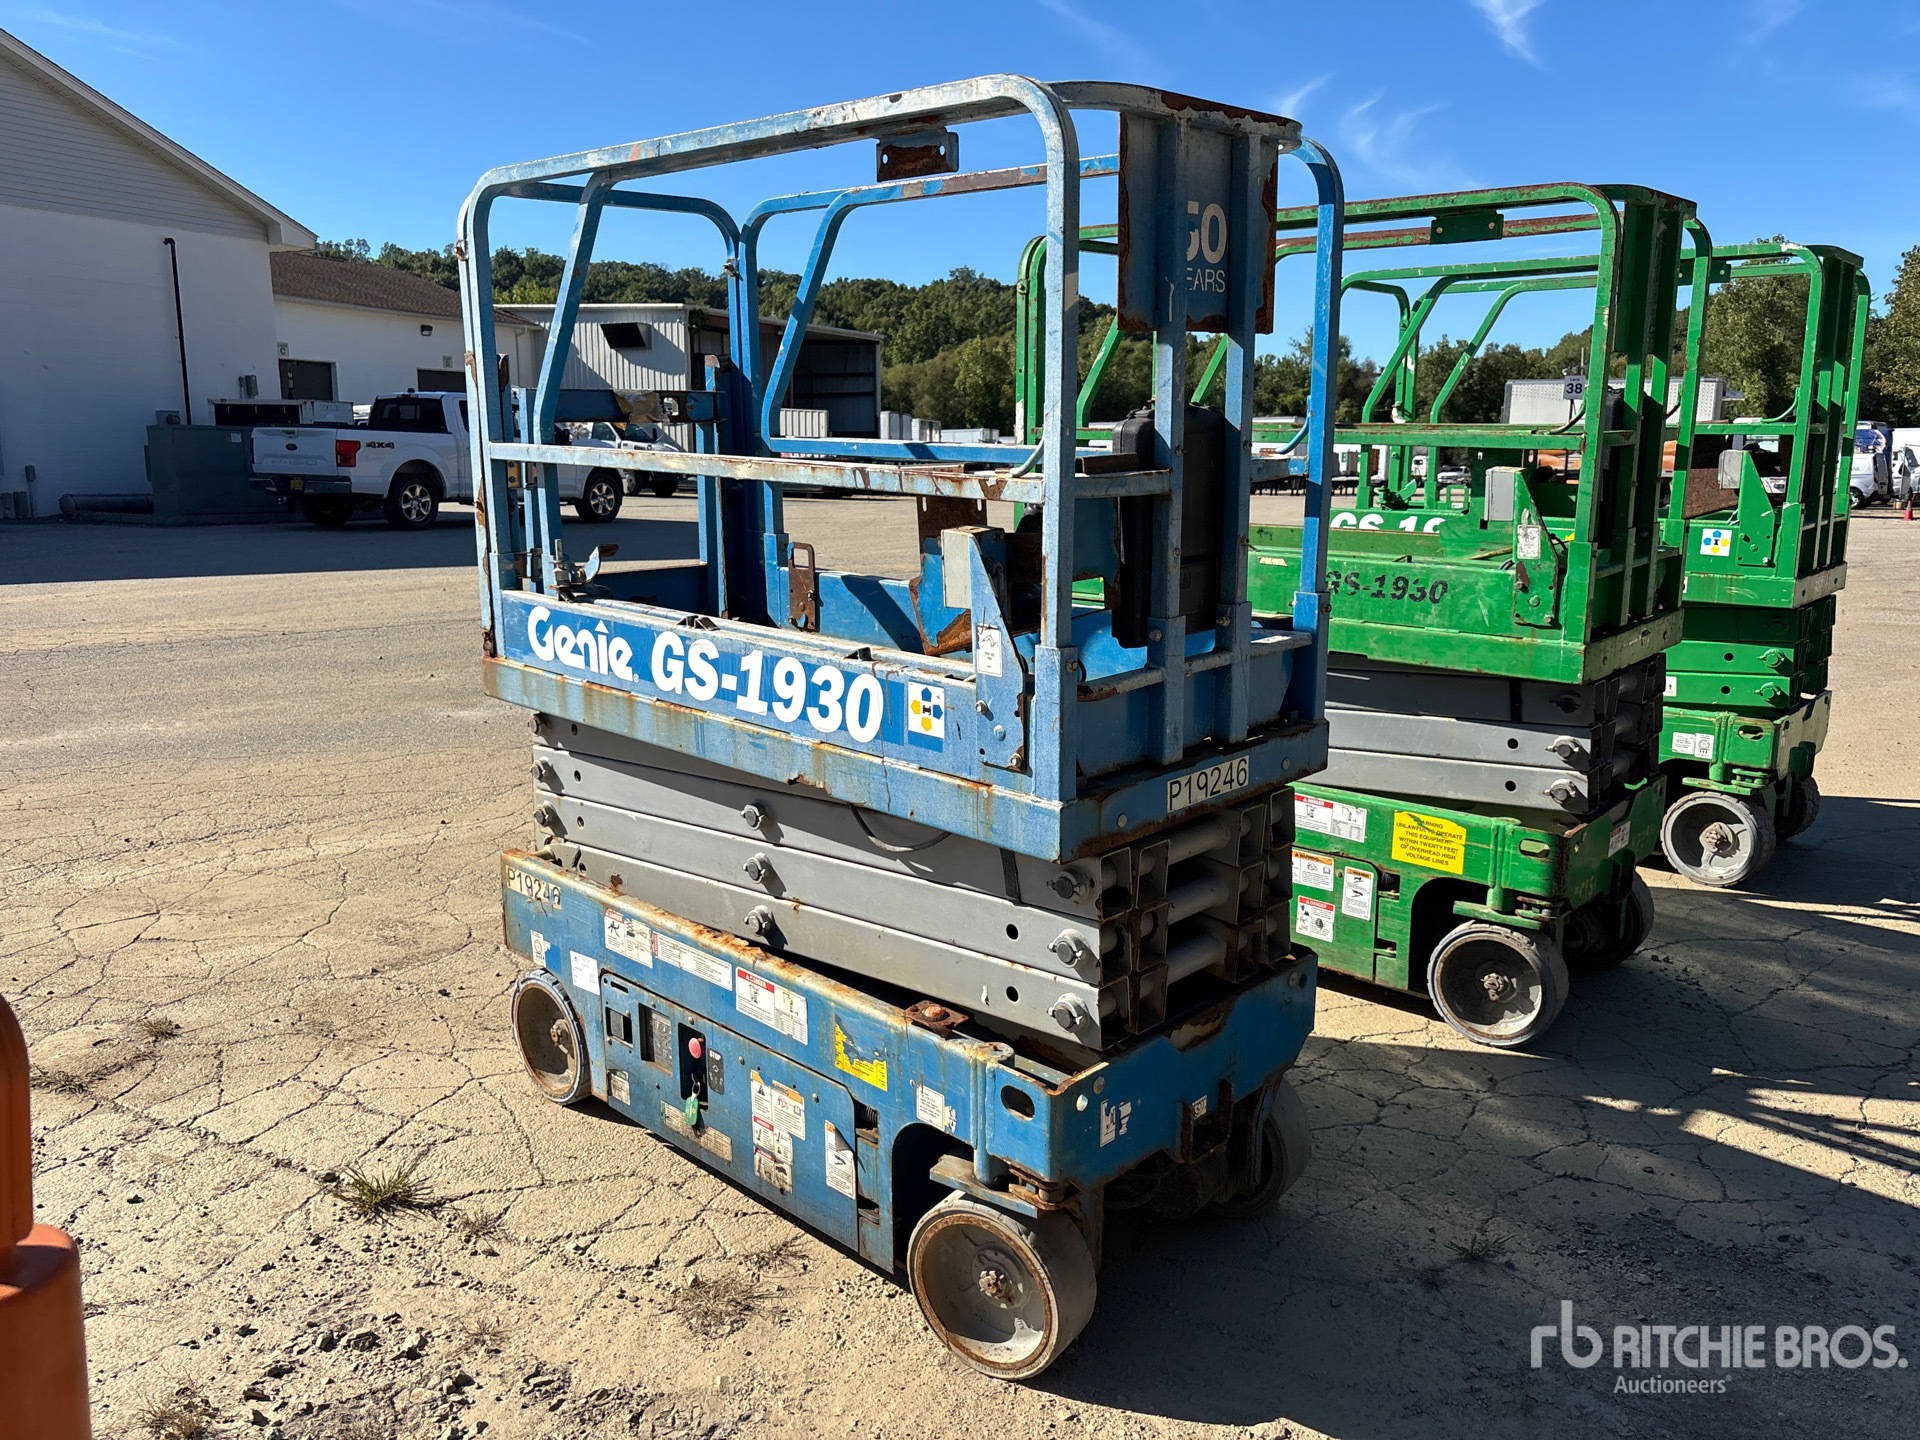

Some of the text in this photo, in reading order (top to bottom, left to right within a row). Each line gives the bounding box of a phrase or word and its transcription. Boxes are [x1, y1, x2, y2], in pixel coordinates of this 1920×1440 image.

[1186, 267, 1226, 293] EARS
[1566, 383, 1583, 394] 38
[651, 631, 884, 743] GS-1930
[1169, 758, 1247, 811] P19246
[1396, 822, 1427, 833] UNLAWFUL
[1436, 830, 1463, 841] OPERATE
[1421, 820, 1444, 829] ARNING
[1399, 836, 1459, 855] WITHIN TWENTY FEET
[1419, 834, 1454, 846] EQUIPMENT
[1405, 851, 1449, 866] VOLTAGE LINES
[1409, 845, 1441, 857] OVERHEAD
[1441, 851, 1456, 861] HIGH
[709, 1050, 721, 1061] STOP
